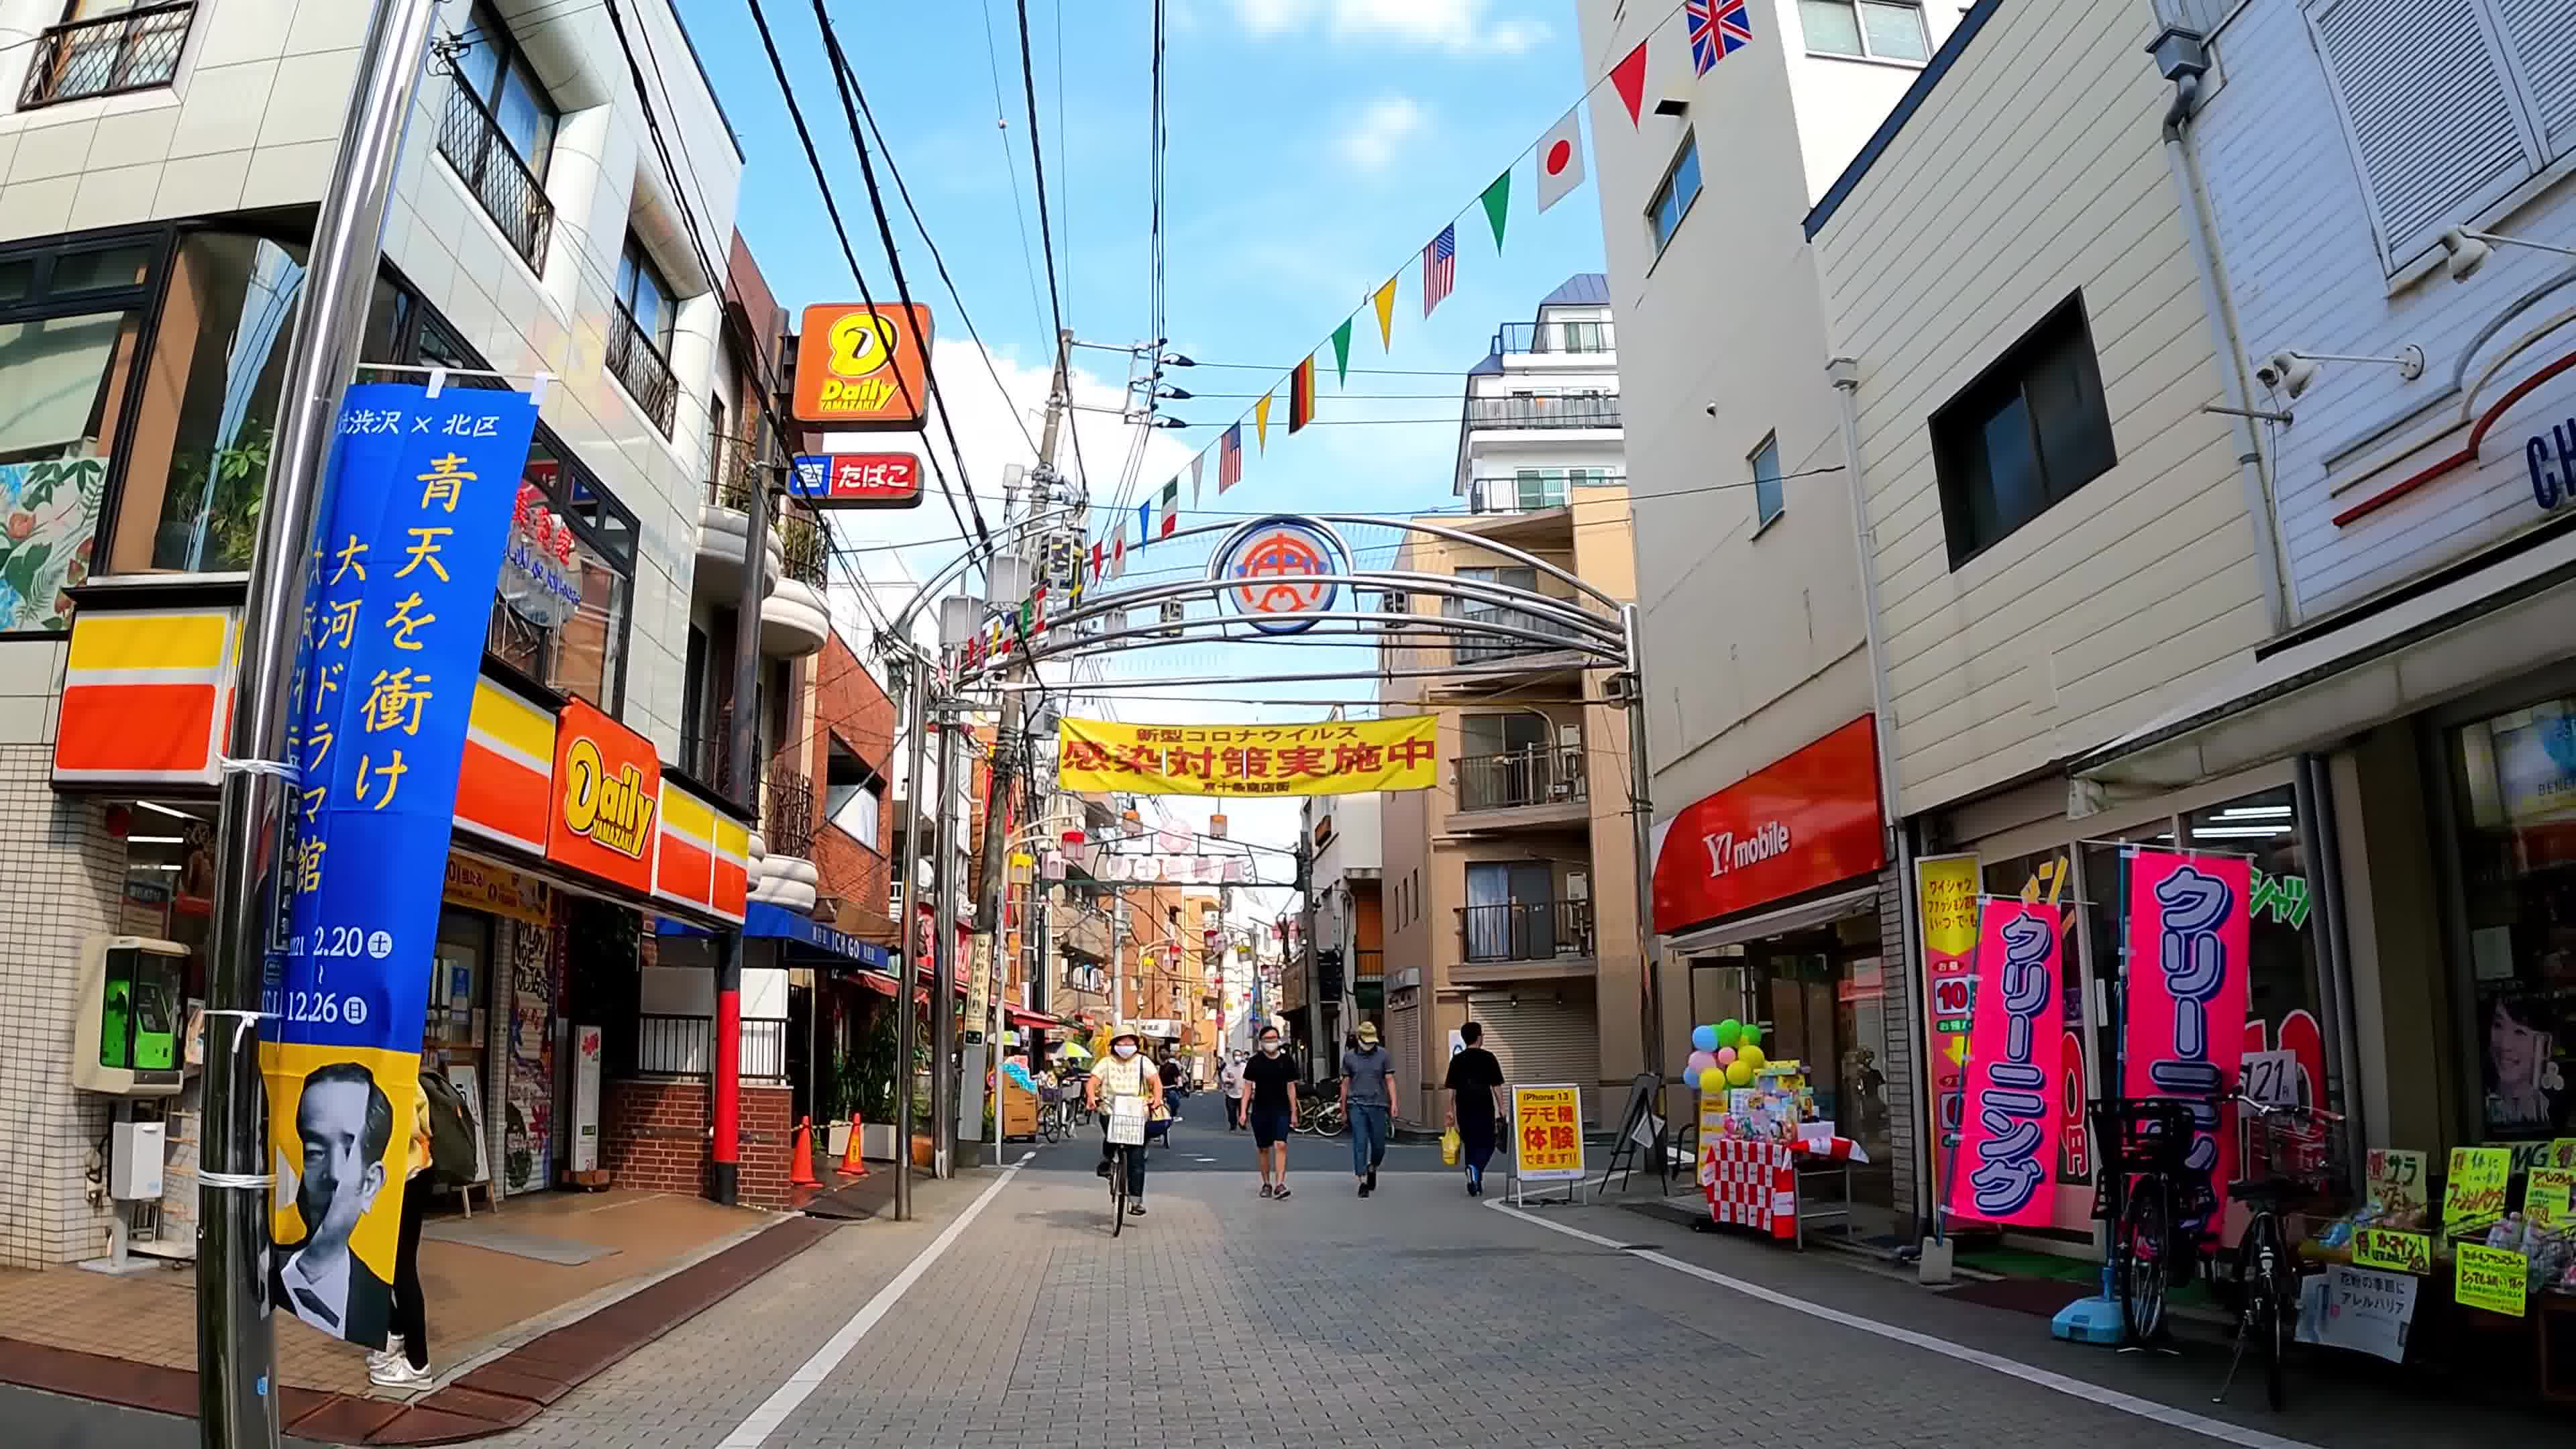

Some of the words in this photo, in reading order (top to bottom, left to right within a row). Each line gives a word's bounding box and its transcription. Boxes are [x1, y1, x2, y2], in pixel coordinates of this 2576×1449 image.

[822, 378, 900, 408] Daily
[441, 413, 500, 437] 北区
[838, 464, 908, 488] たばこ
[343, 451, 479, 811] 青天を衝け
[297, 534, 369, 894] 大河ドラマ館
[1136, 727, 1360, 743] 新型コロナウイルス
[1063, 736, 1436, 780] 感染対策実施中
[566, 739, 655, 857] Daily
[593, 818, 635, 850] YAMAZAKI
[313, 926, 363, 957] 2.20
[368, 930, 392, 959] 土
[343, 996, 368, 1024] 日
[1971, 912, 2052, 1215] クリーニング
[1558, 1092, 1569, 1101] 13
[1523, 1126, 1574, 1150] 体験
